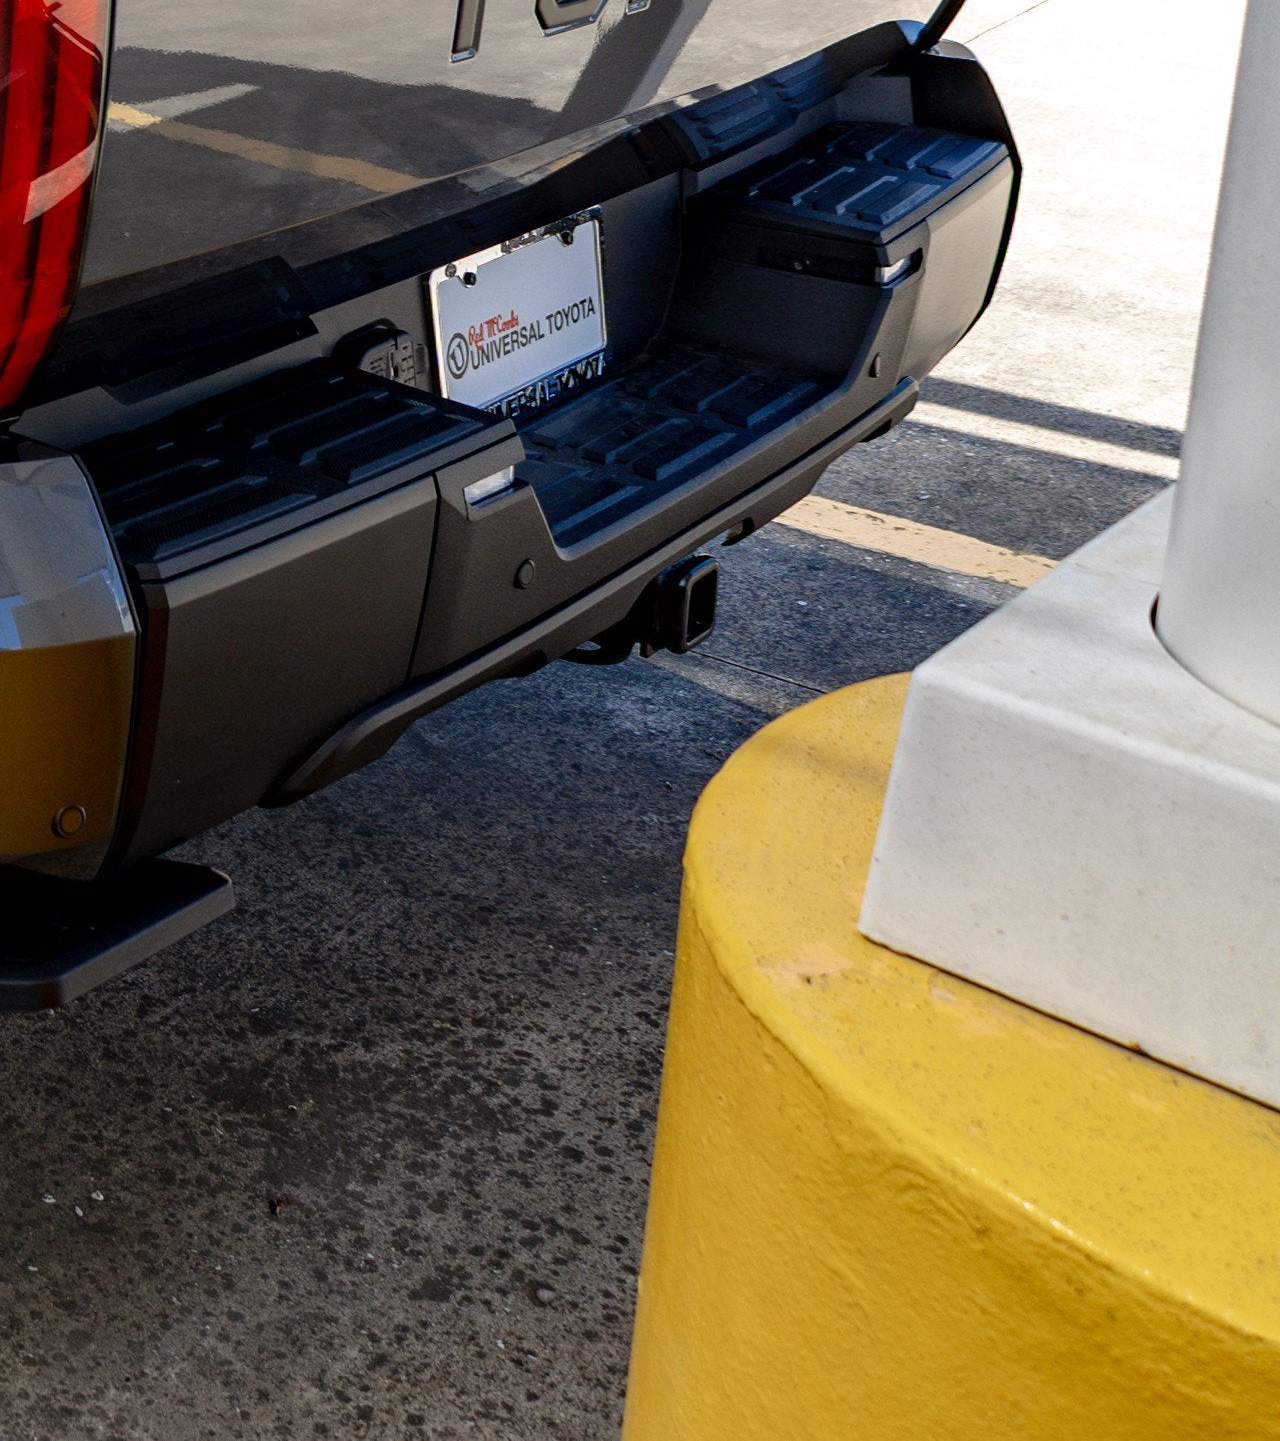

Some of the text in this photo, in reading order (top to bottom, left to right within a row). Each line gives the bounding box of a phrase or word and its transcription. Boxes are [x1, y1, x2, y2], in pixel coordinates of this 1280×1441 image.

[469, 324, 485, 346] Red
[470, 296, 597, 371] UNIVERSAL TOYOTA
